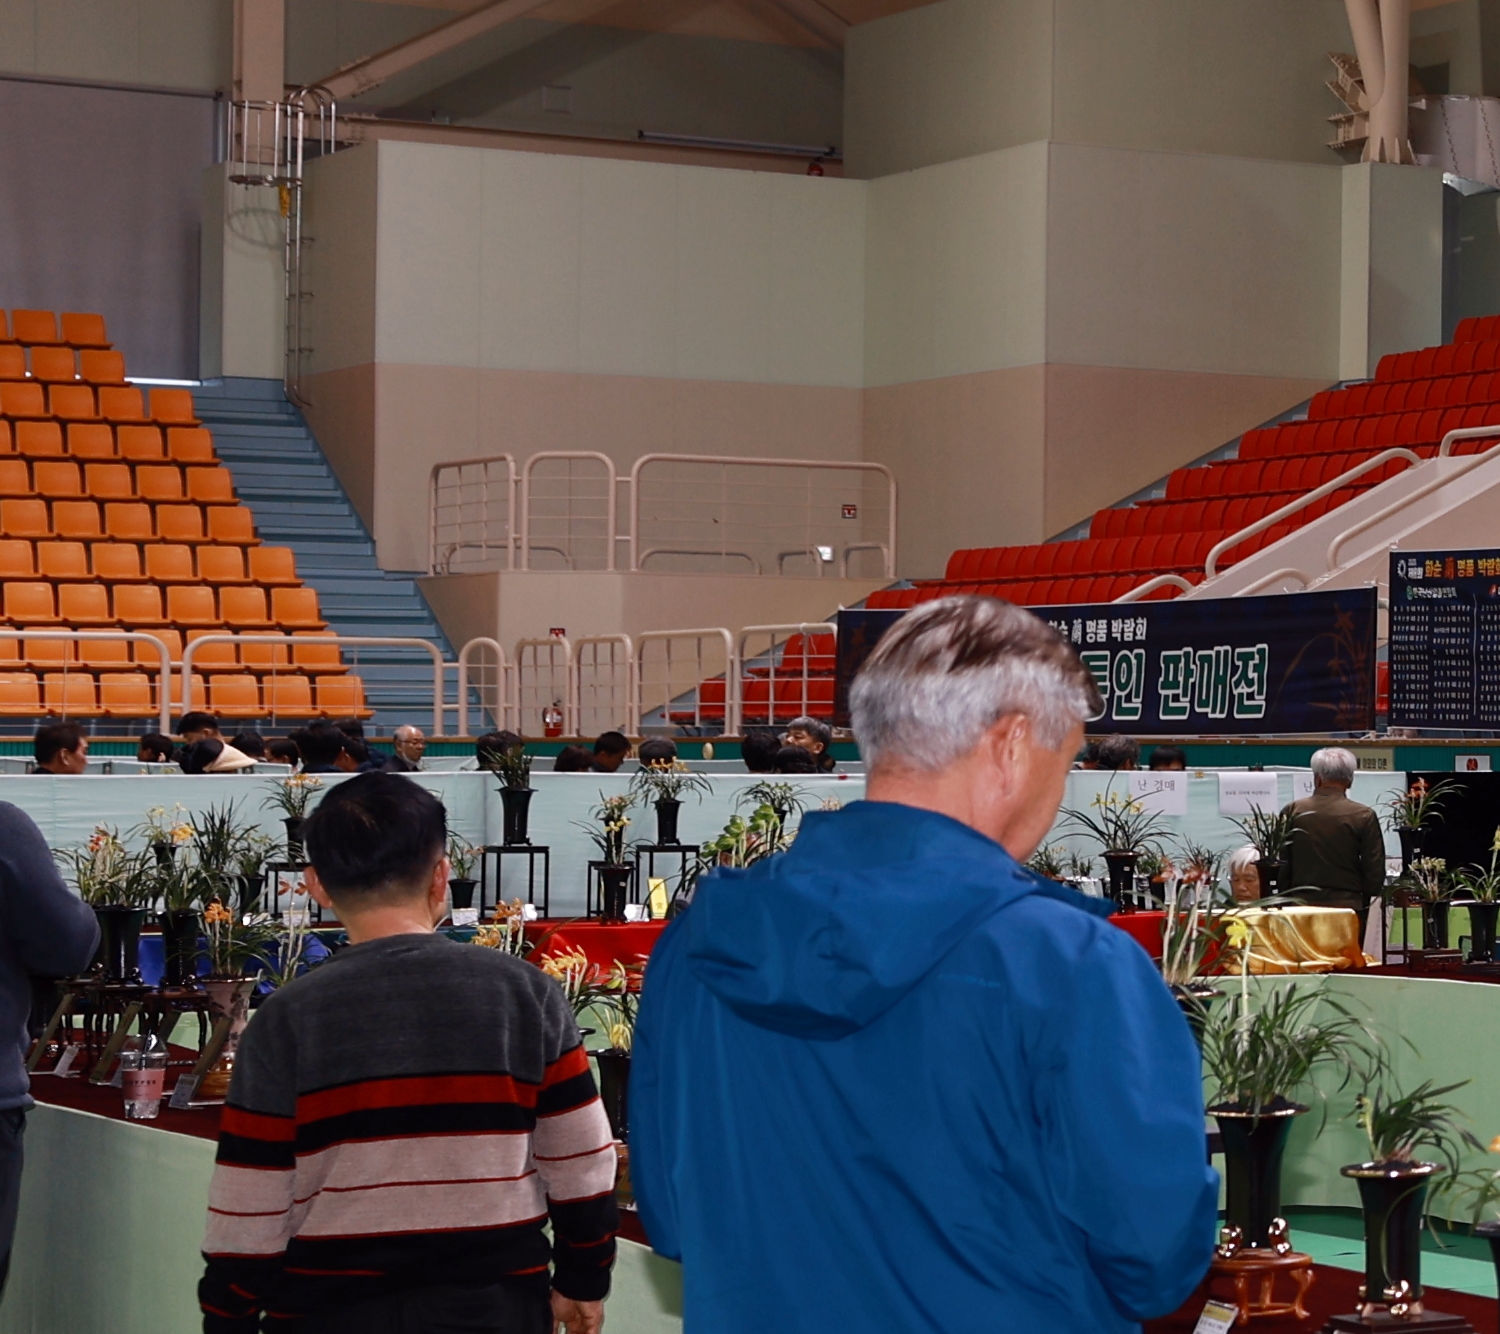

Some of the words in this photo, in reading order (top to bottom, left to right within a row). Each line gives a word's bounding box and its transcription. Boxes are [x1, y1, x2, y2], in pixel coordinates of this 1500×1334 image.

[1086, 619, 1108, 643] 명품
[1111, 616, 1147, 642] 박람회
[1158, 642, 1269, 720] 판매전
